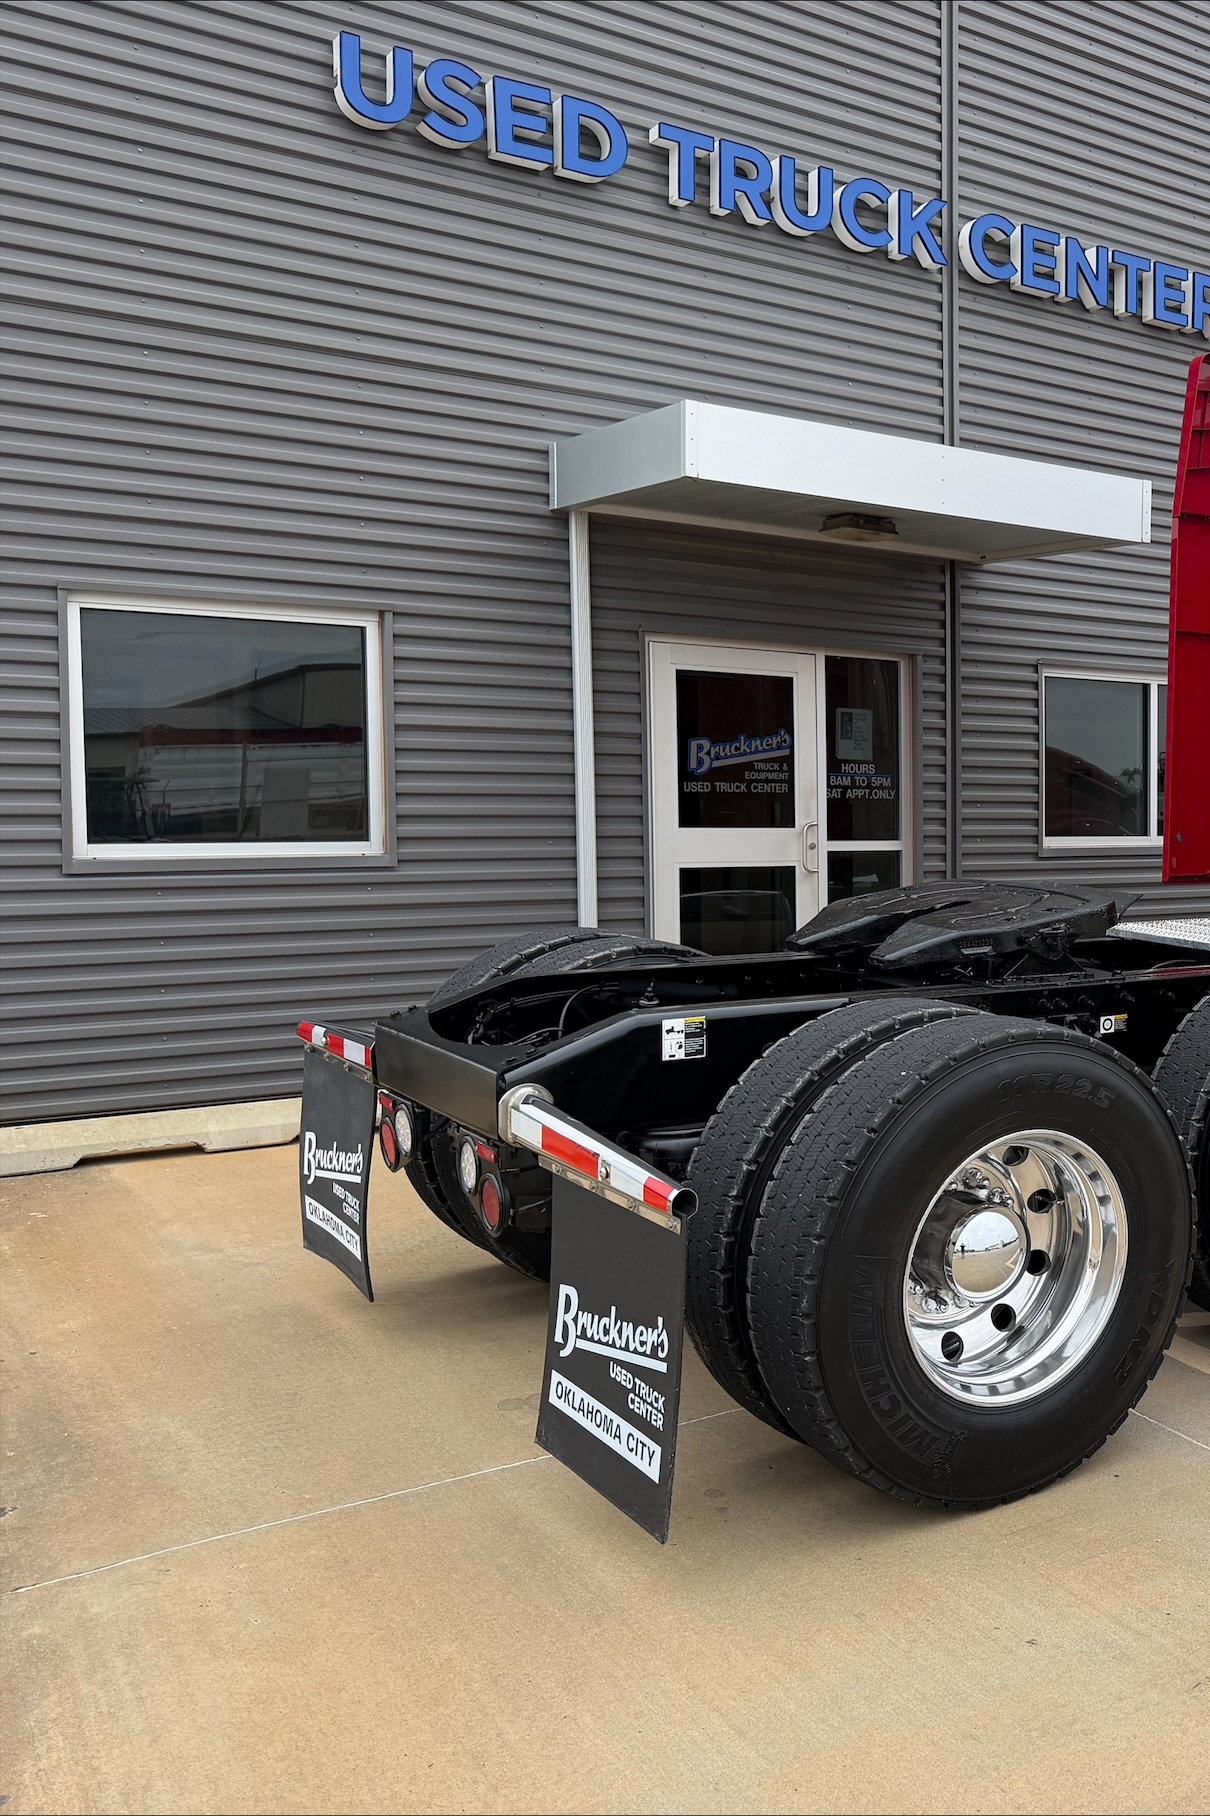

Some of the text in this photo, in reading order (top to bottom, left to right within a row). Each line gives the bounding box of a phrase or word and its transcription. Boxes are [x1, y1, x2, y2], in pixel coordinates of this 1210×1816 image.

[334, 31, 628, 184] USED
[649, 121, 948, 270] TRUCK
[688, 729, 791, 775] Bruckner's
[753, 762, 789, 771] TRUCK &
[841, 763, 876, 774] HOURS
[683, 781, 789, 793] USED TRUCK CENTER
[744, 771, 789, 780] EQUIPMENT
[829, 775, 891, 787] 8AM TO 5PM
[304, 1131, 363, 1184] Bruckner's
[308, 1202, 359, 1251] OKLAHOMA CITY
[554, 1283, 669, 1358] Bruckner's
[609, 1361, 665, 1413] USED TRUCK
[555, 1380, 656, 1468] OKLAHOMA CITY
[627, 1392, 665, 1431] CENTER
